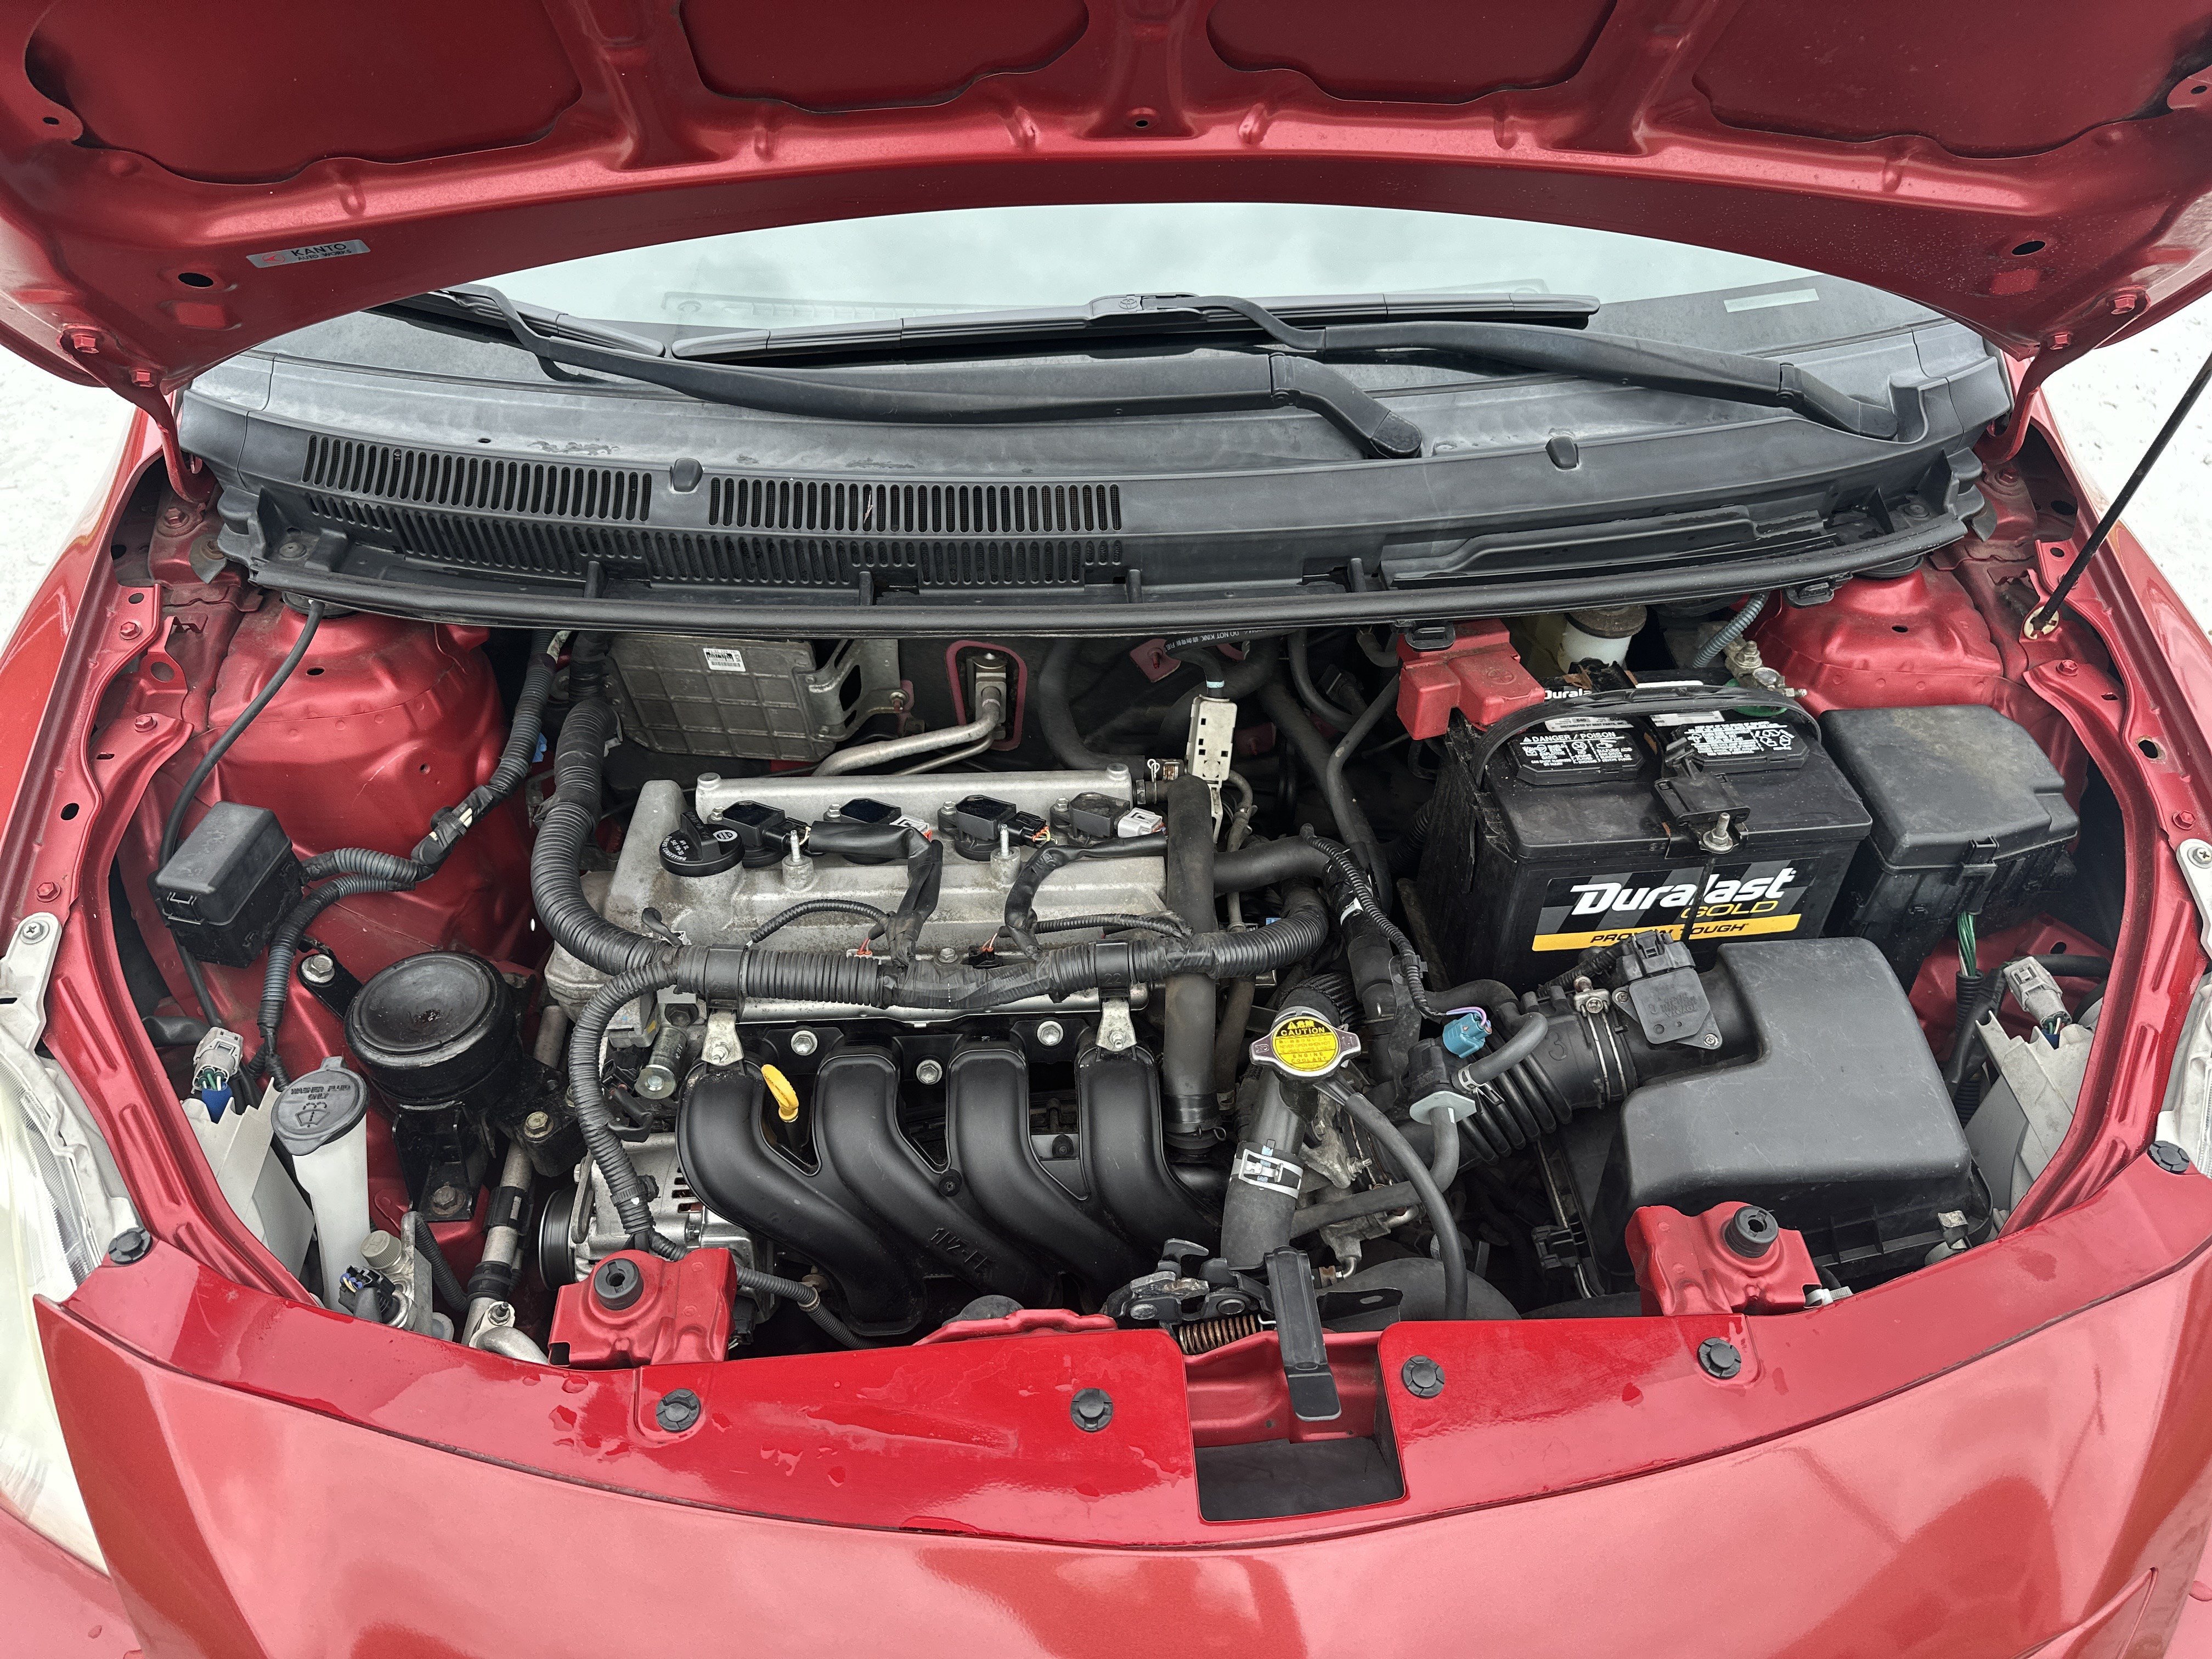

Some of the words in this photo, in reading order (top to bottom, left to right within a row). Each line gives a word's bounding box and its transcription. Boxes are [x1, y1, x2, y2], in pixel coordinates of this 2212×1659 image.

[291, 244, 347, 256] KANTO
[1680, 900, 1778, 919] GOLD
[1679, 924, 1747, 934] OUGH
[1104, 973, 1121, 984] 22
[1280, 1027, 1325, 1036] CAUTION
[1544, 1031, 1567, 1061] 3
[291, 1086, 324, 1094] WASHER
